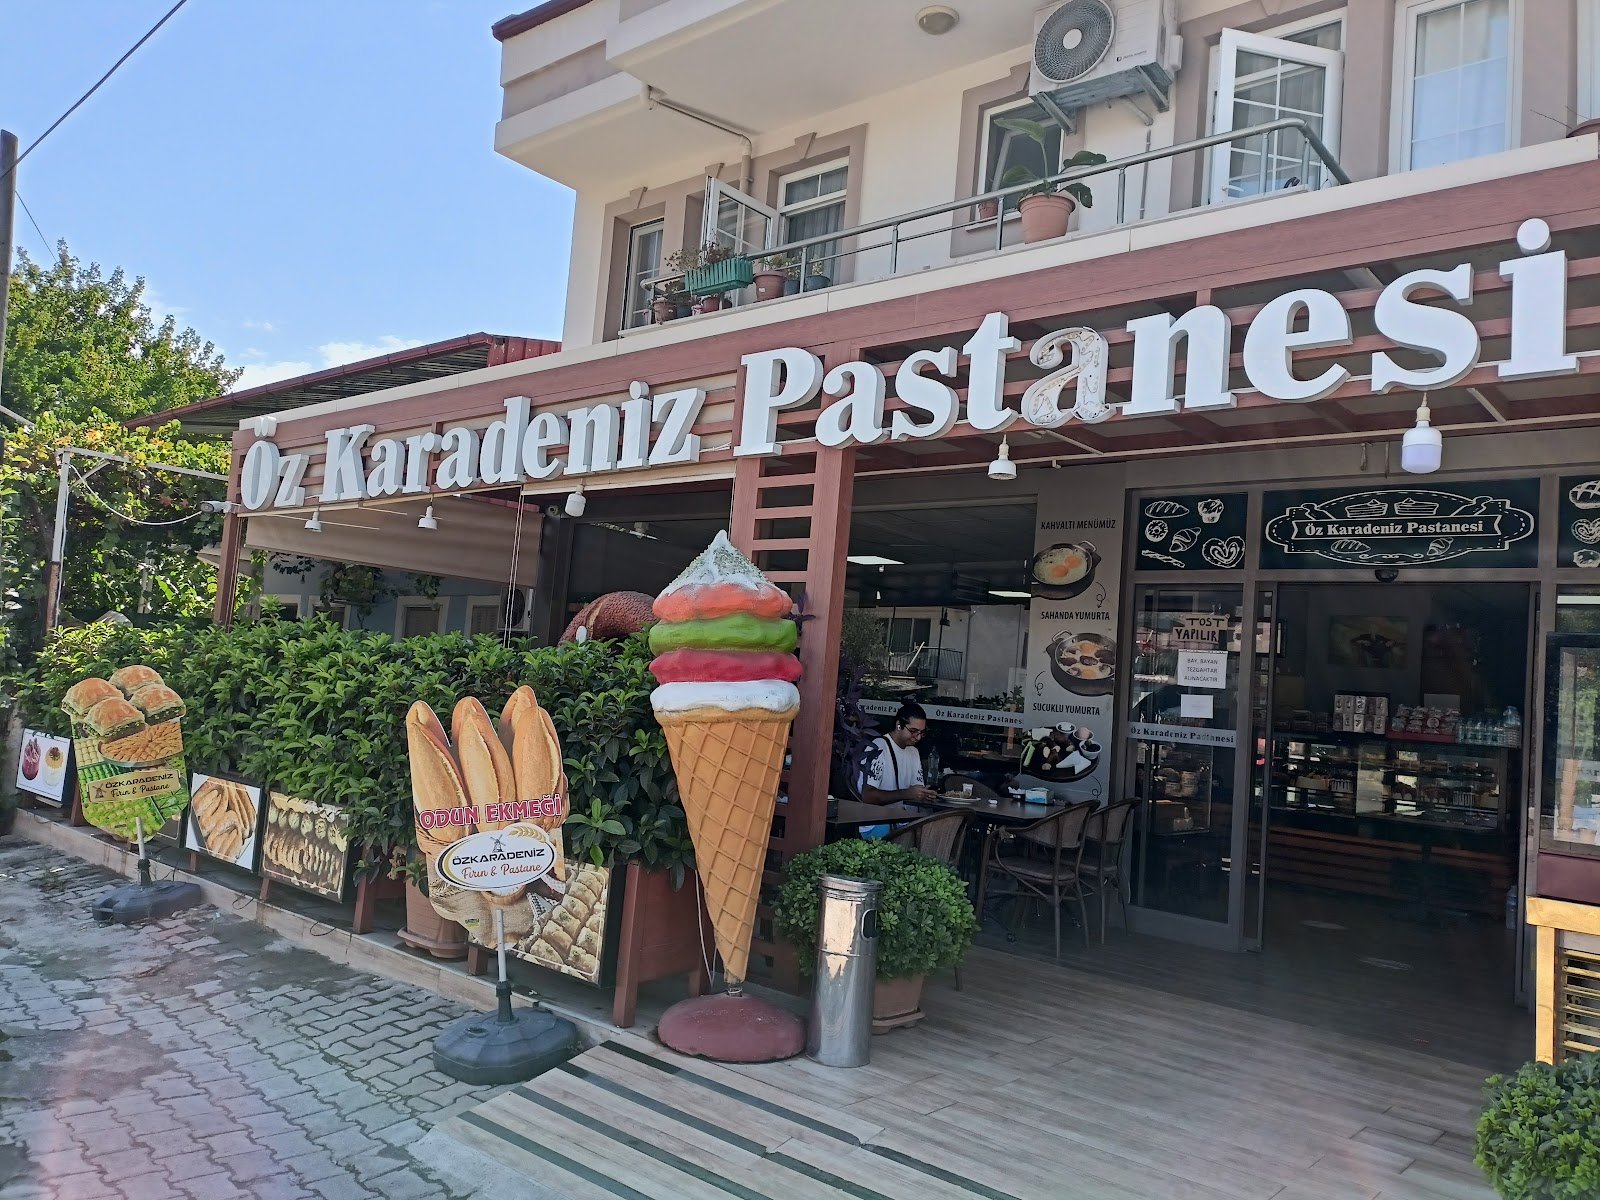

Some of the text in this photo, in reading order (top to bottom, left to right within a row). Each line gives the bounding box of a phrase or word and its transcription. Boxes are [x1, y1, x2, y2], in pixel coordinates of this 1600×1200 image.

[241, 217, 1581, 513] Öz Karadeniz Pastanesi
[1040, 519, 1116, 530] KAHVALTI MENÜMÜZ
[1305, 520, 1483, 536] Öz Karadeniz Pastanesi
[1041, 611, 1110, 621] SAHANDA YUMURTA
[1186, 617, 1224, 627] TOST
[1175, 628, 1218, 642] YAPILIR
[1187, 666, 1218, 674] TEZGAHTAR
[859, 704, 887, 712] aradeniz
[1033, 702, 1100, 715] SUCUKLU YUMURTA
[947, 710, 985, 721] Karadeniz
[987, 713, 1024, 725] Pastanes
[1143, 728, 1188, 739] Karadeniz
[105, 773, 173, 789] ÖZKARADENİZ
[140, 783, 170, 794] Pastane
[419, 793, 562, 830] ODUN EKMEĞİ
[452, 847, 545, 866] ÖZKARADENİZ
[461, 863, 542, 879] Fırın & Pastane
